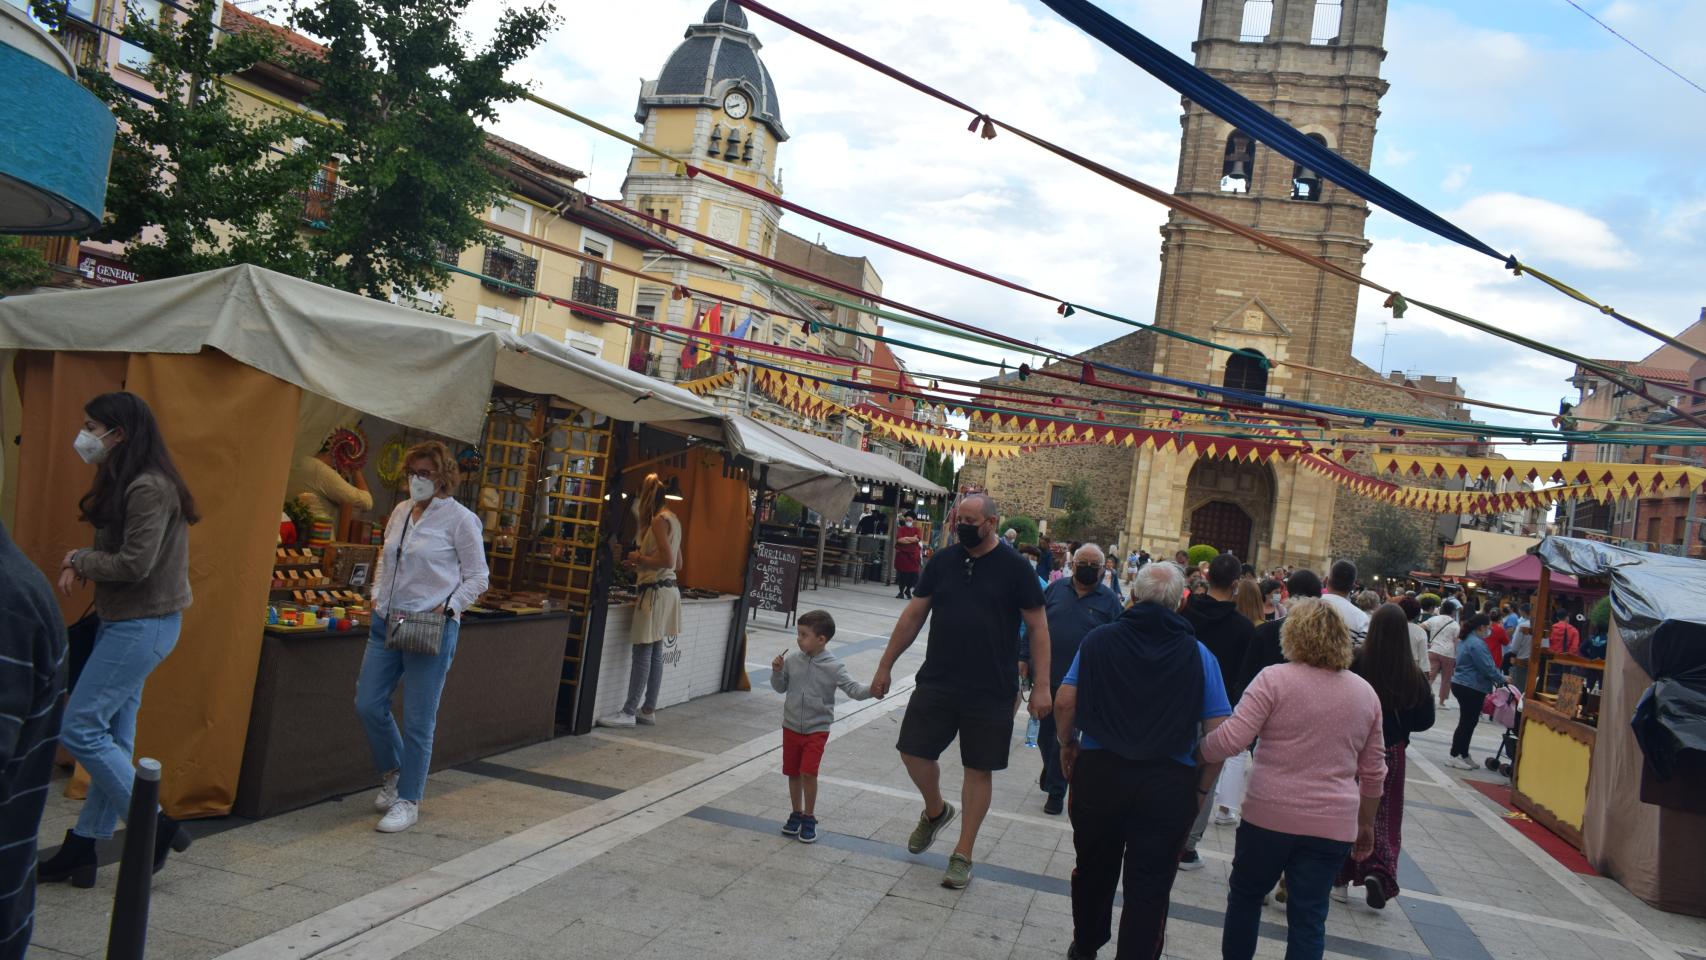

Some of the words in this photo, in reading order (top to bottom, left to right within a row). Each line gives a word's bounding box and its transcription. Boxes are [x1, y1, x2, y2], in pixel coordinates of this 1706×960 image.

[757, 544, 796, 564] PARRILLADA
[756, 563, 784, 575] CARNE
[749, 589, 783, 604] GALLEGA
